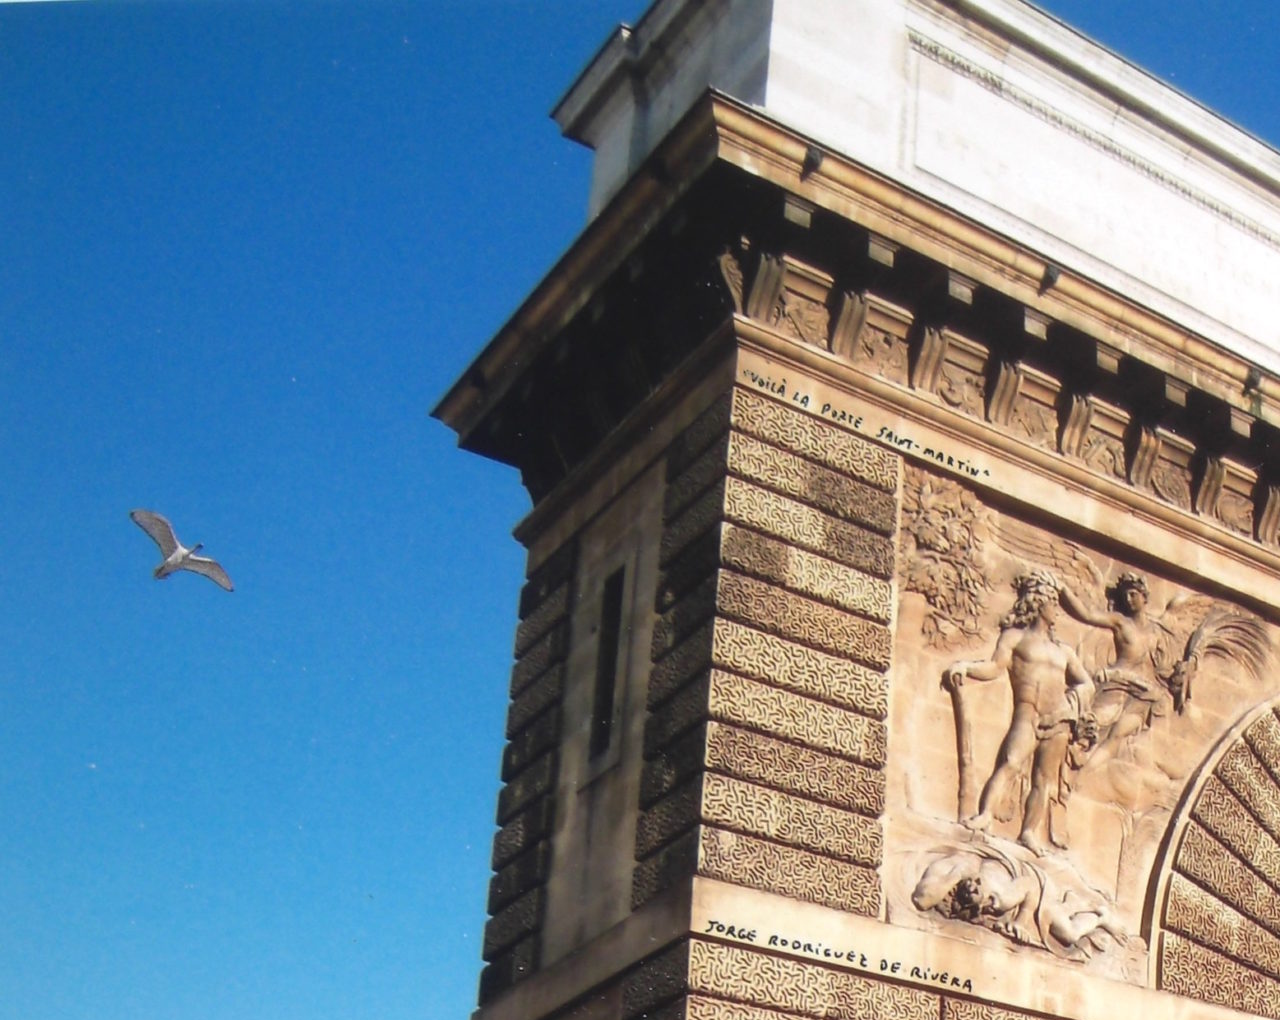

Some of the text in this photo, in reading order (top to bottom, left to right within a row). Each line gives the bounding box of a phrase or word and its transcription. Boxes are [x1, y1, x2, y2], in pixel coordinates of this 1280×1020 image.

[792, 392, 810, 408] LA
[705, 920, 757, 942] JORGE
[880, 959, 901, 973] DE
